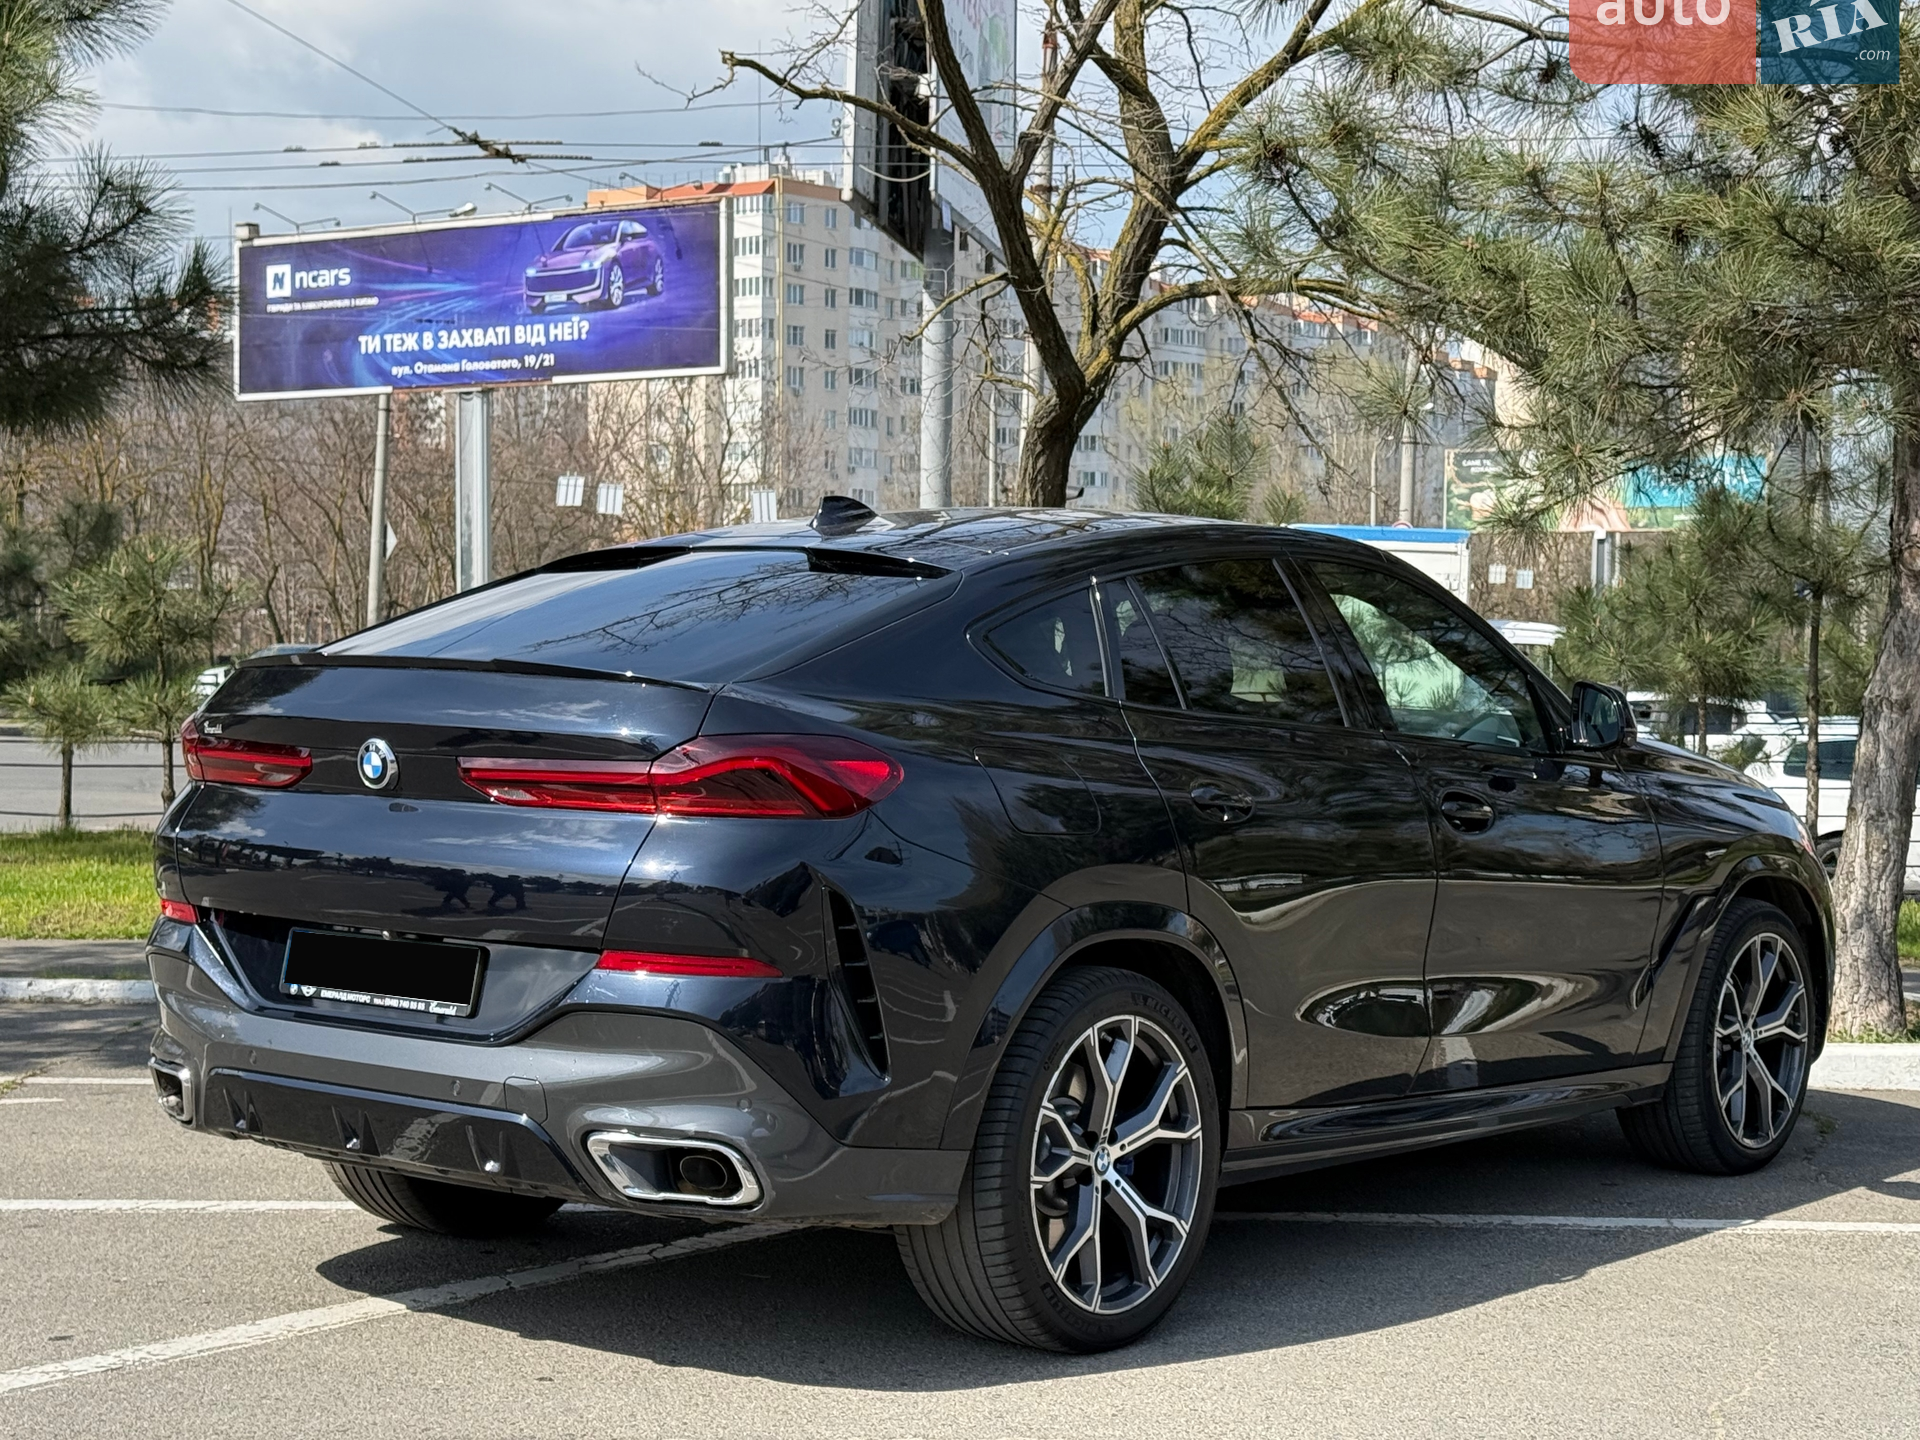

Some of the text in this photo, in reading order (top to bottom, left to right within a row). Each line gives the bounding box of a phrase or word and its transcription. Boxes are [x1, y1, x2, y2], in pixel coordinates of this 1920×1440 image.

[294, 267, 352, 290] ncars
[358, 315, 590, 355] ТИ ТЕЖ В ЗАХВАТІ ВІД НЕЇ?
[391, 353, 555, 379] вул. Отамана Головатого, 19/21
[1145, 997, 1197, 1051] MICHELIN
